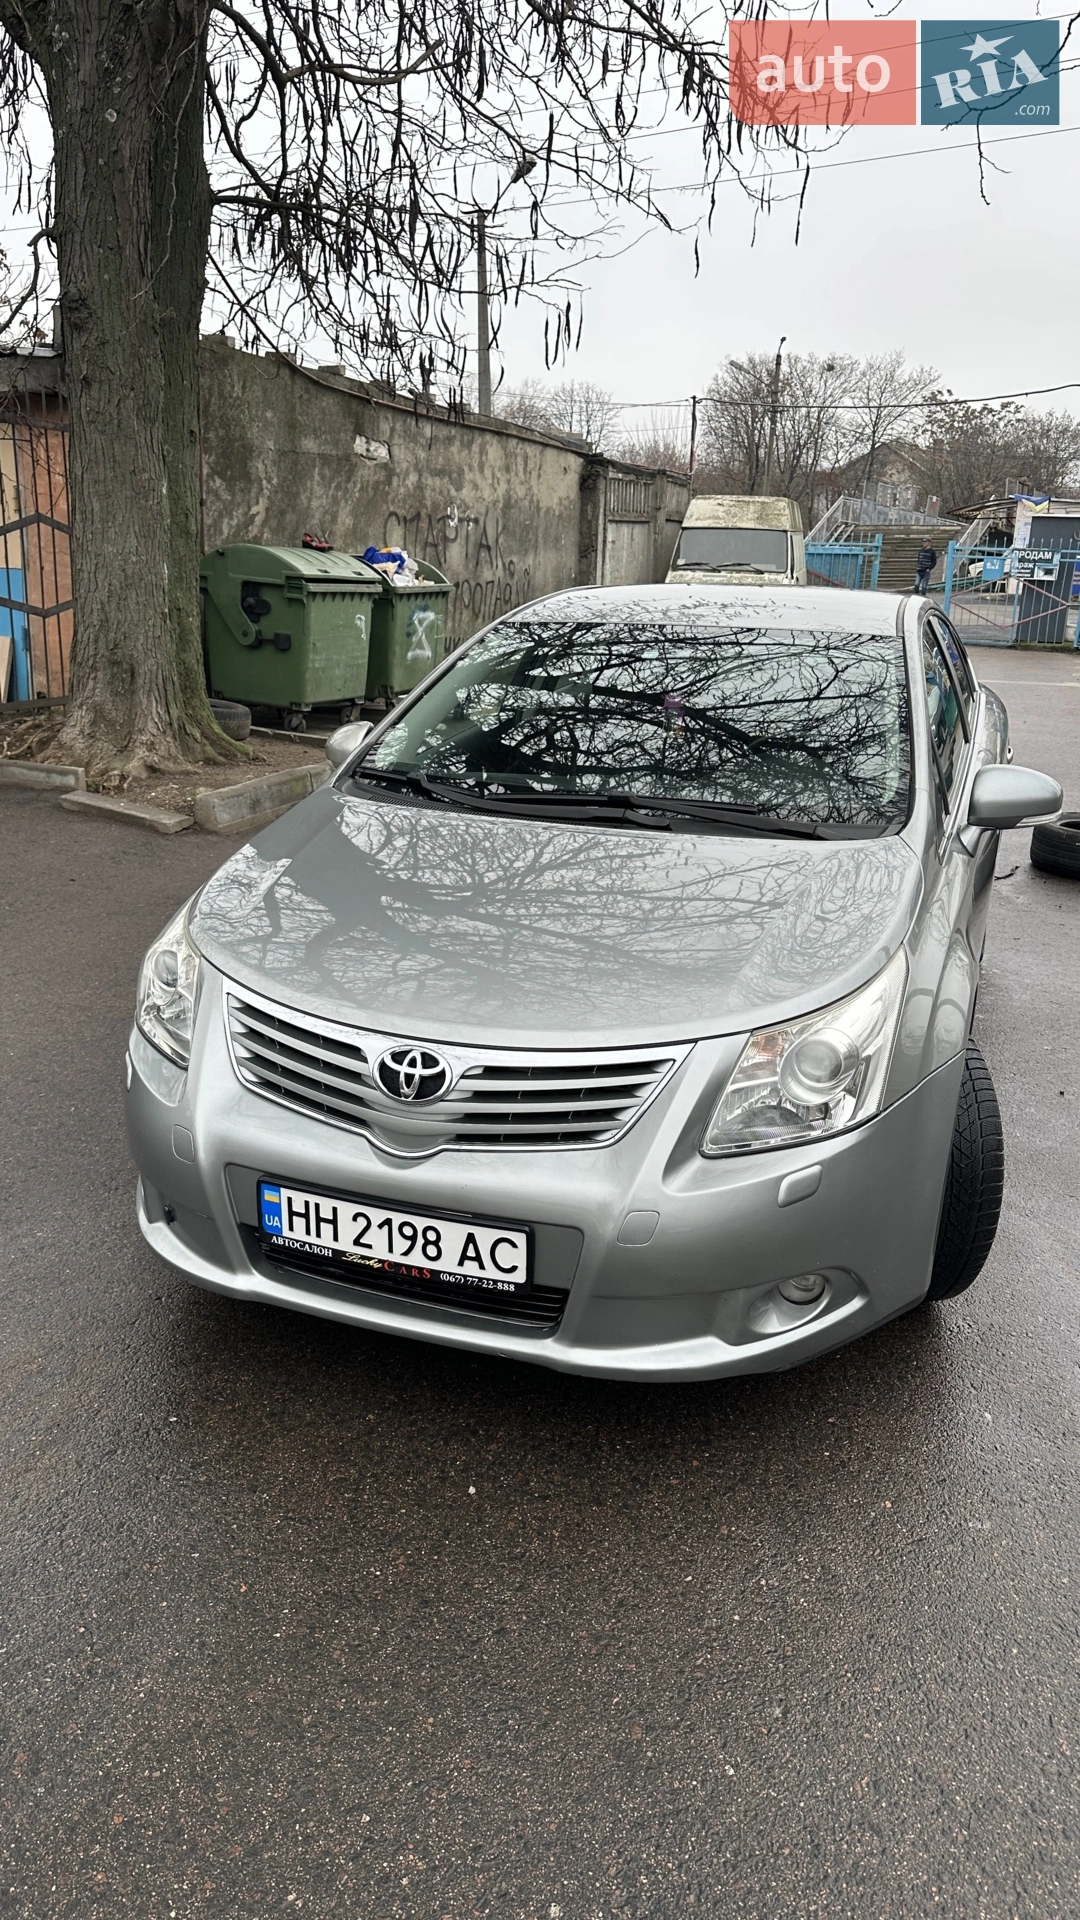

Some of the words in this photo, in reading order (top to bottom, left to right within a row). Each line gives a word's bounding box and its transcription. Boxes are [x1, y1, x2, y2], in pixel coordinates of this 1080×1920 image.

[1013, 551, 1052, 559] ПРОДАМ
[265, 1214, 281, 1228] UA
[271, 1235, 333, 1257] АВТОСАЛОН
[287, 1196, 339, 1242] HH
[352, 1211, 443, 1262] 2198
[457, 1232, 519, 1274] AC
[342, 1252, 383, 1268] Lucky
[440, 1273, 464, 1284] (067)
[466, 1276, 516, 1292] 77-22-888
